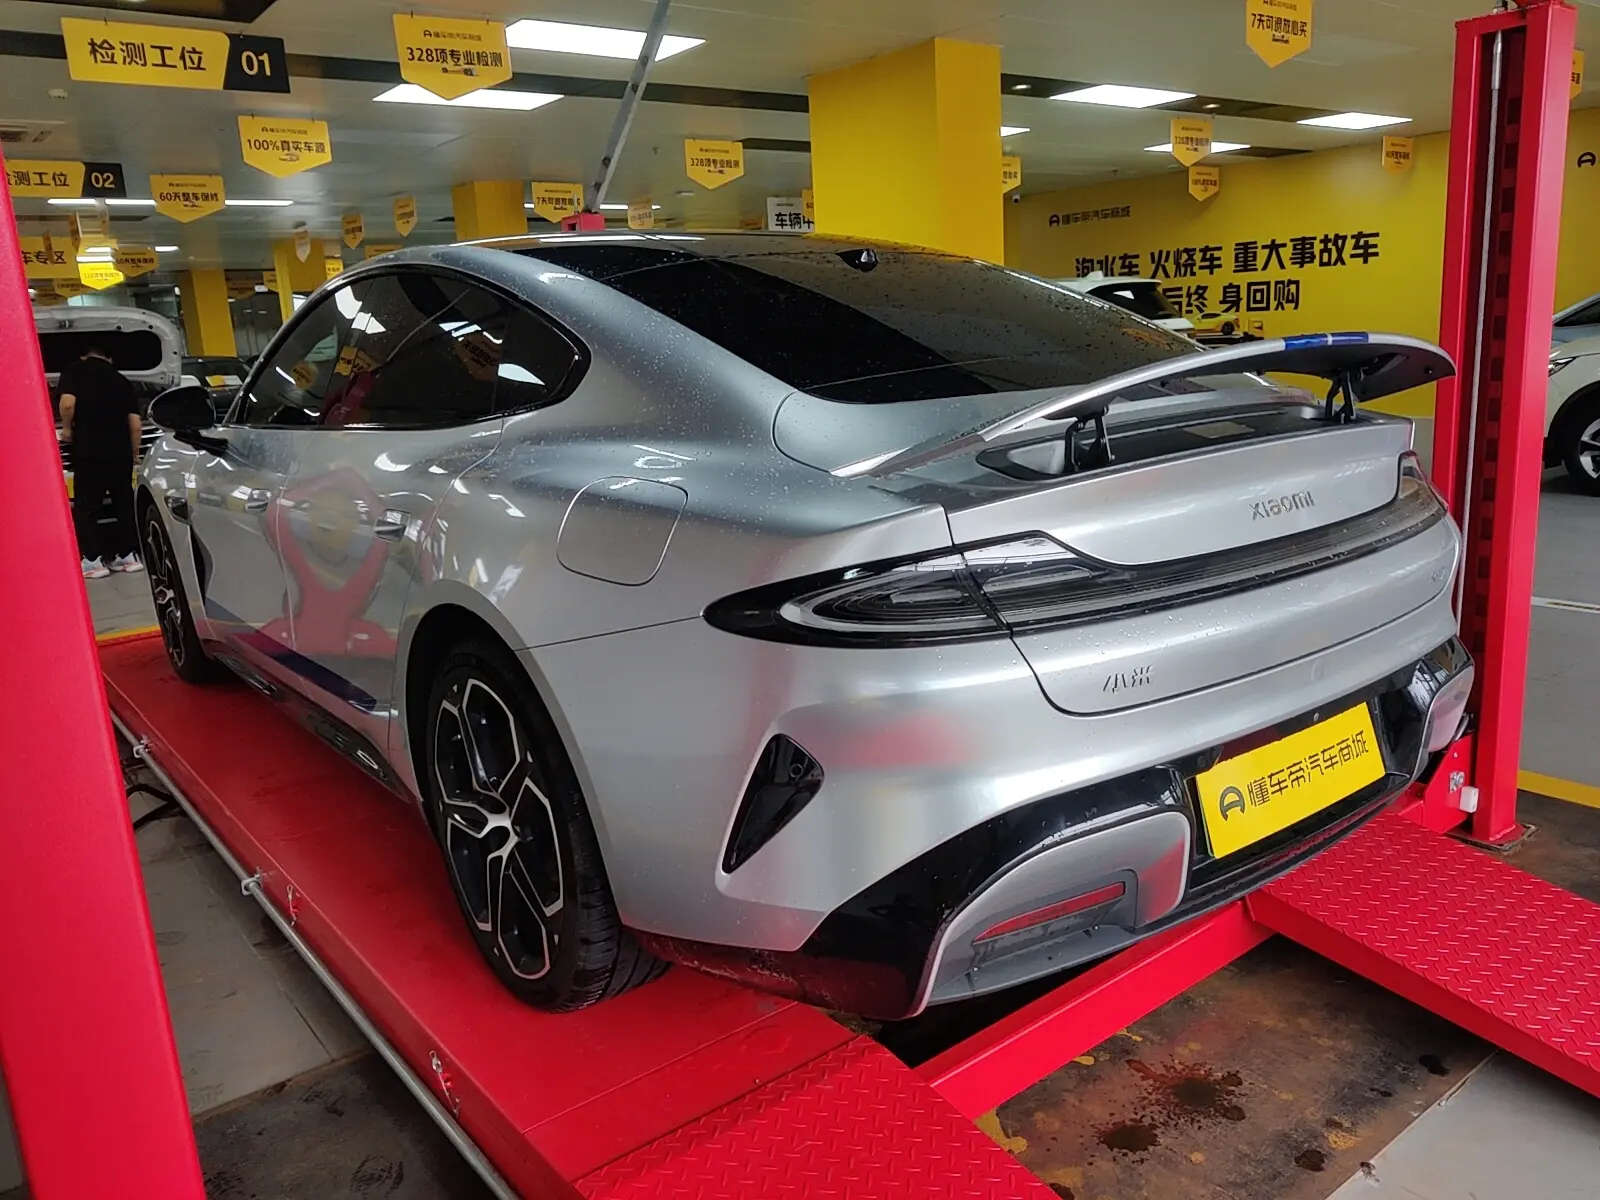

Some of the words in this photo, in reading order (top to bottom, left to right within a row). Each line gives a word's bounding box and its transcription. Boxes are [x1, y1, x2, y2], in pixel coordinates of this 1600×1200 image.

[88, 37, 206, 71] 检测工位
[241, 50, 271, 77] 01
[406, 46, 503, 67] 328项专业检测
[247, 138, 326, 153] 100%真实车源
[91, 171, 116, 188] 02
[1150, 245, 1223, 279] 火烧车
[1233, 230, 1380, 274] 重大事故车
[1102, 664, 1151, 694] 小米
[1247, 729, 1369, 808] 懂车帝汽车商城
